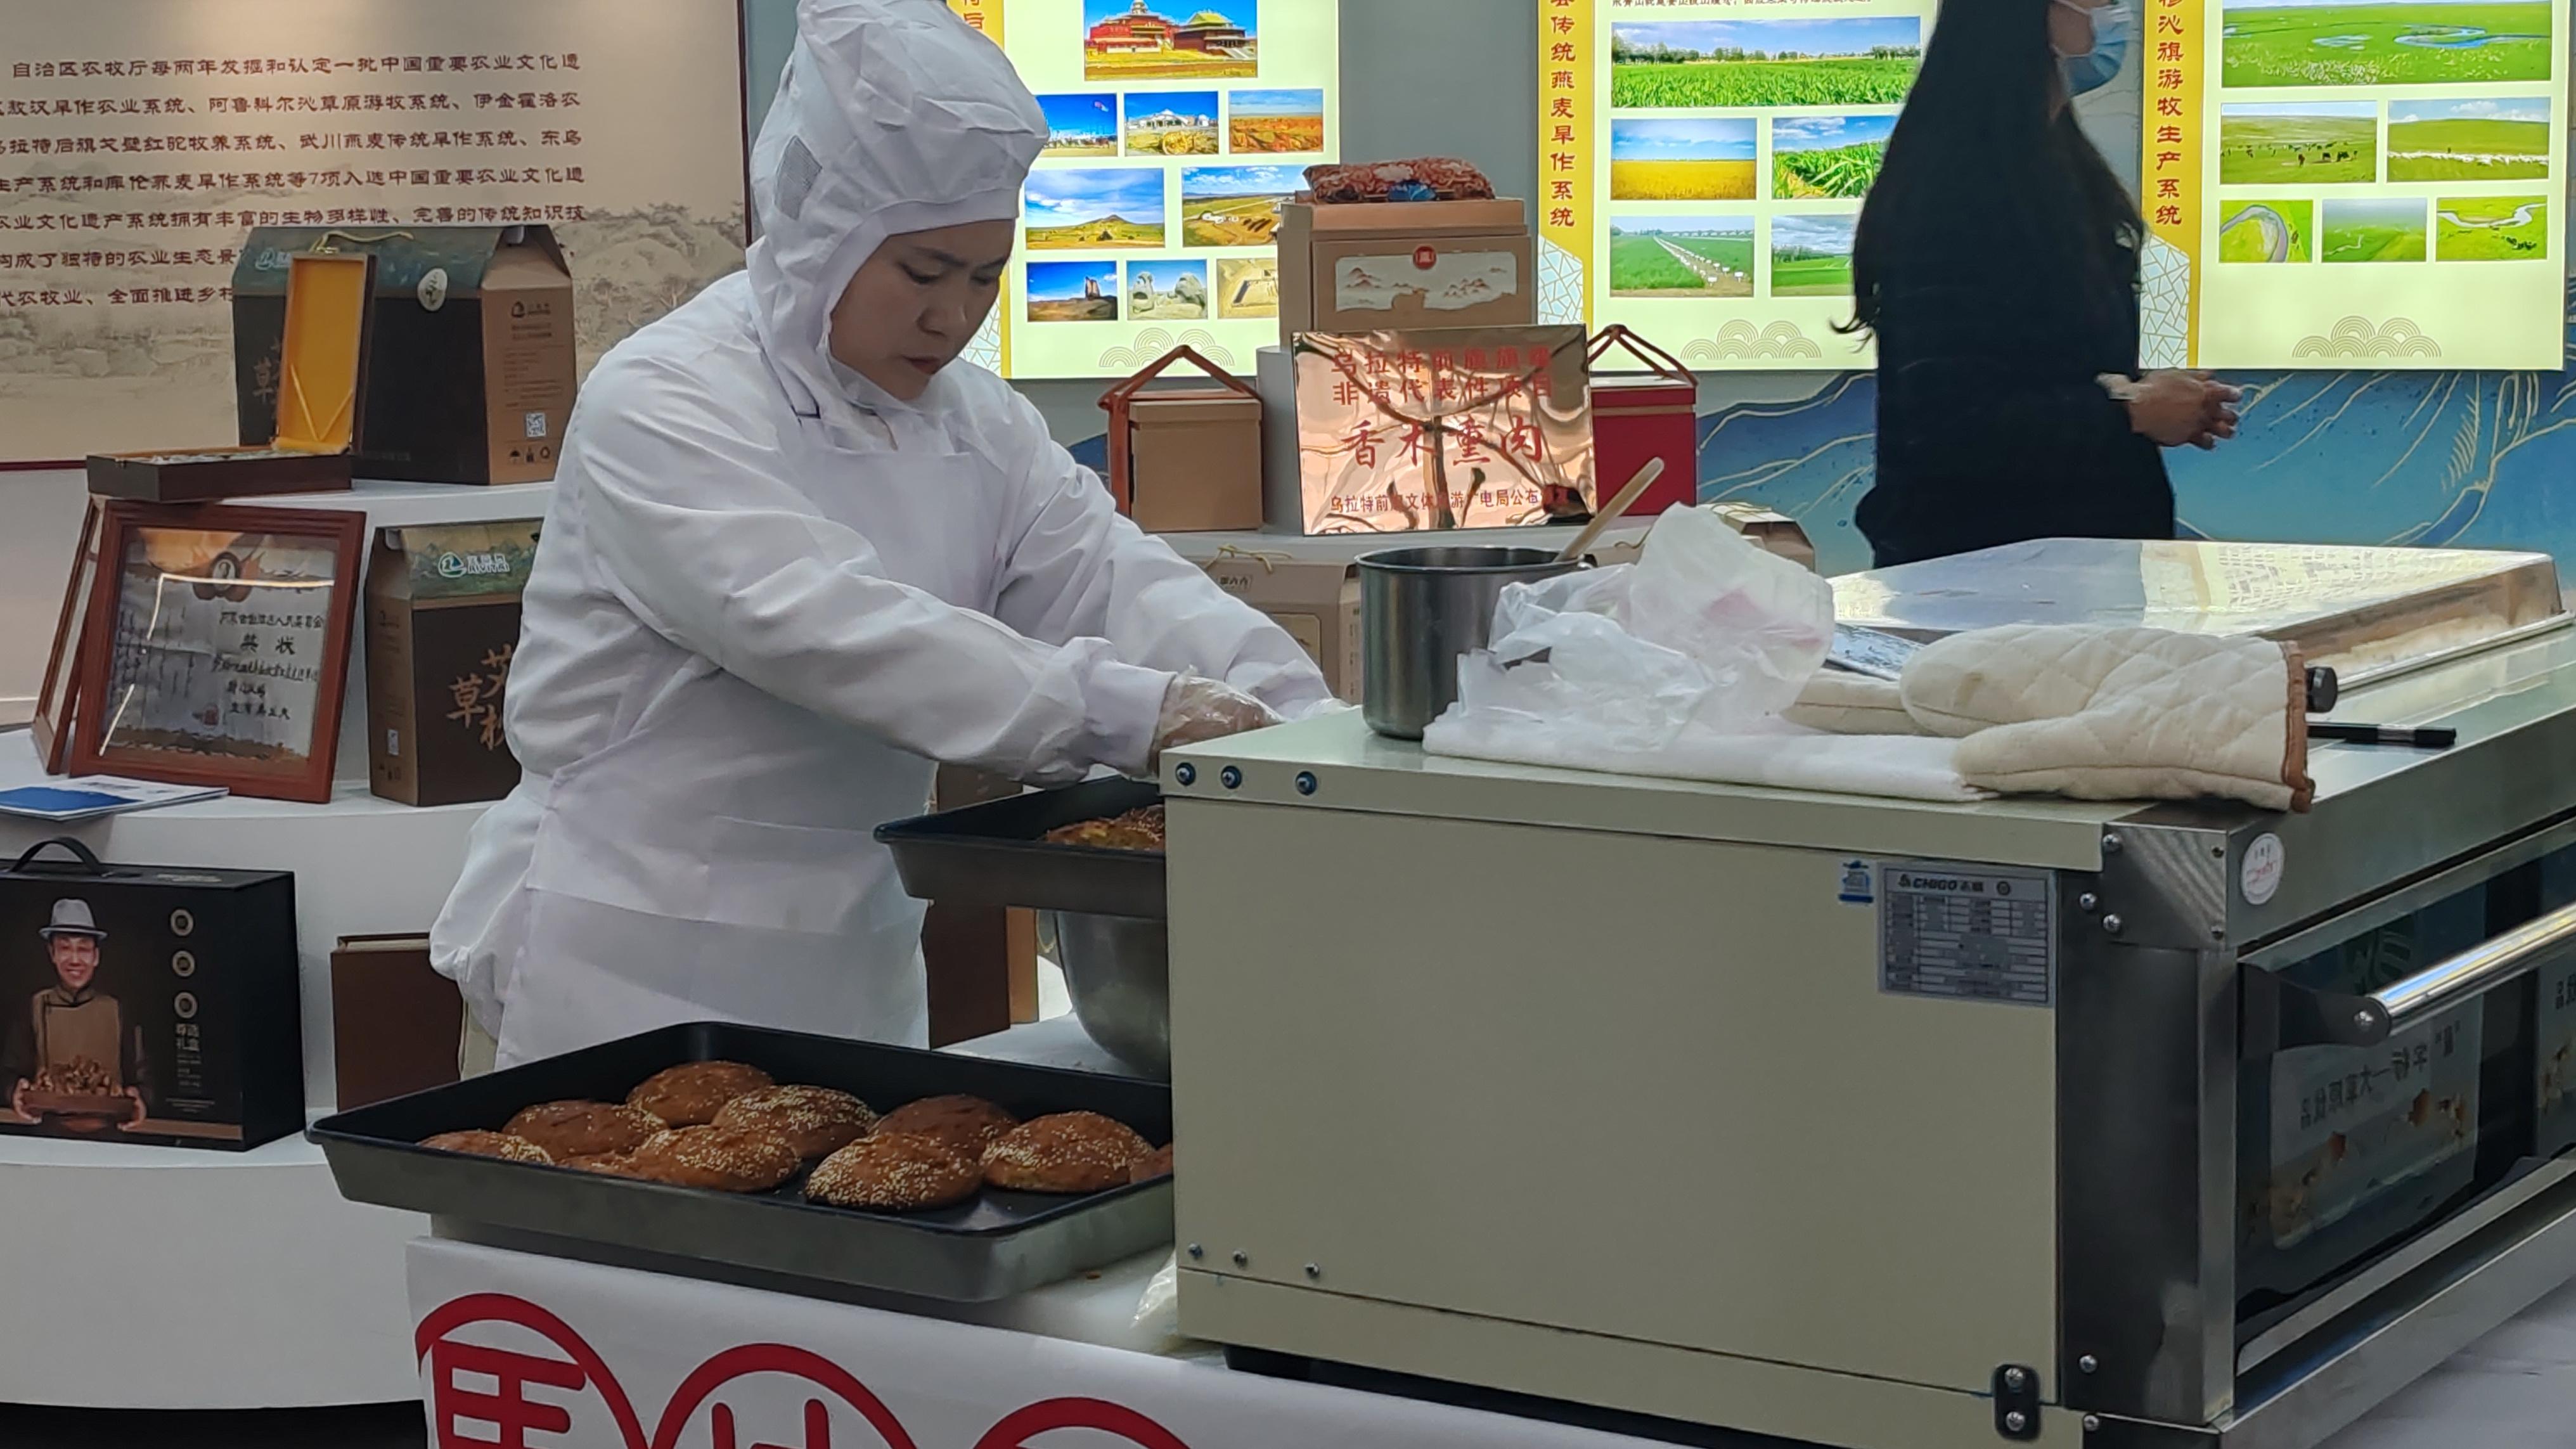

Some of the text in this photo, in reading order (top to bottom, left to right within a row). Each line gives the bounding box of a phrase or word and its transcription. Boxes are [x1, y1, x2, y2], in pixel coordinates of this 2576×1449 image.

[0, 93, 581, 117] 敖汉旱作农业系统、阿鲁科尔沁草原游牧系统、伊金霍洛农
[0, 248, 243, 269] 构成了独特的农业生态景
[1331, 488, 1539, 512] 乌拉特前文体游电局公布
